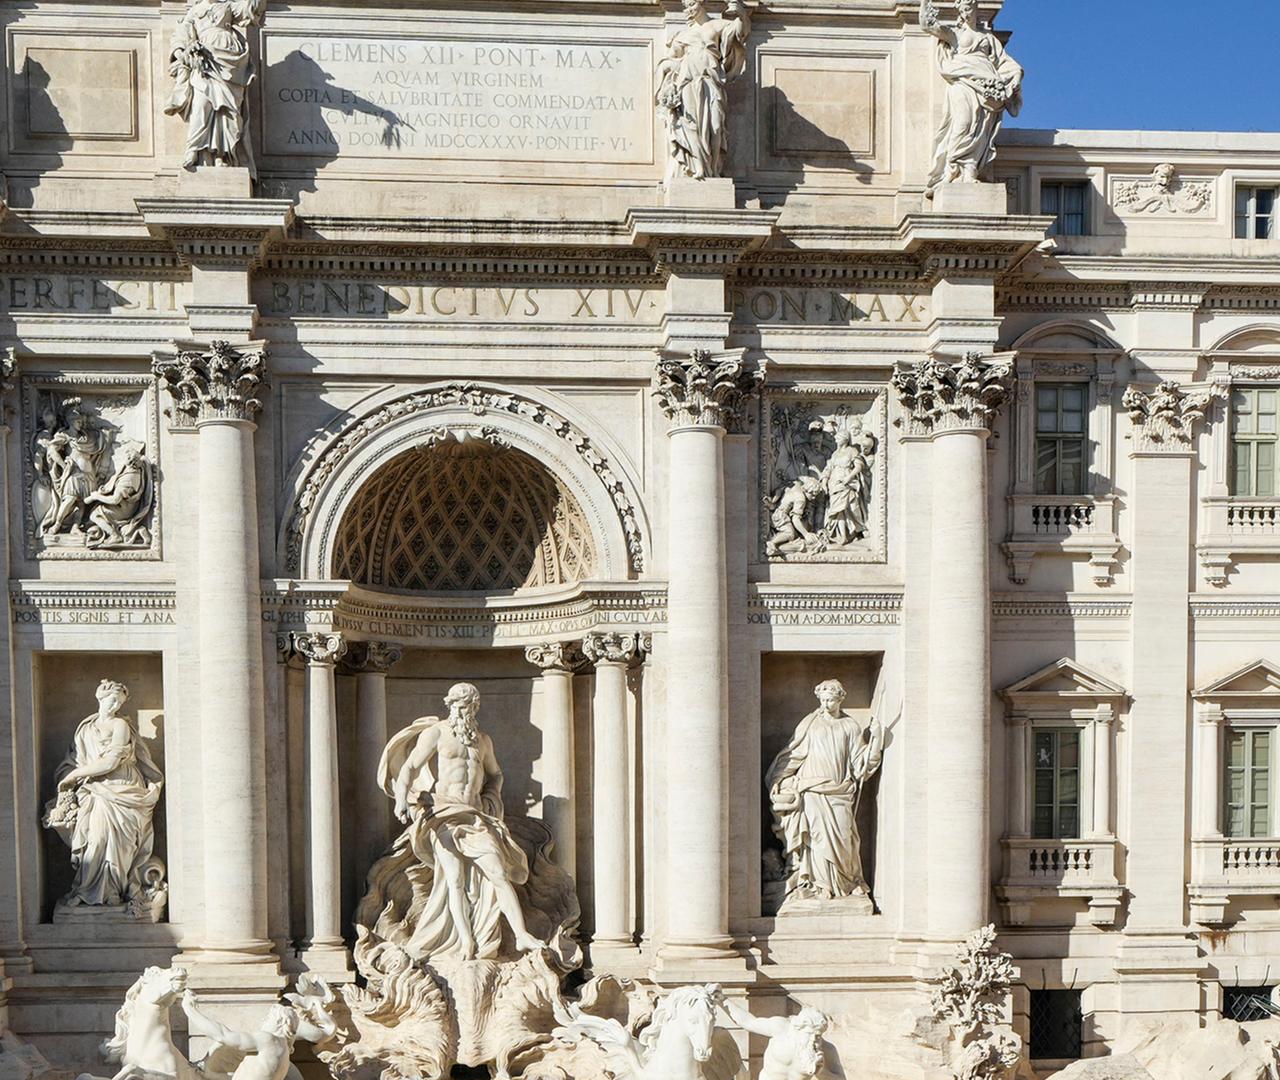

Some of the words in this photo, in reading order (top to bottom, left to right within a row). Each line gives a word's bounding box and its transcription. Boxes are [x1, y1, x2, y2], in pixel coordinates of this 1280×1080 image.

[299, 42, 408, 64] CLEMENS
[372, 71, 440, 88] AQVAM
[452, 72, 544, 88] VIRGINEM
[278, 88, 331, 104] COPIA
[341, 90, 361, 104] ET
[367, 91, 483, 107] SALVBRITATE
[493, 94, 635, 111] COMMENDATAM
[397, 112, 501, 129] MAGNIFICO
[509, 115, 592, 130] ORNAVIT
[288, 131, 342, 145] ANNO
[348, 131, 416, 148] DOMINI
[270, 280, 542, 317] BENEDICTVS
[69, 611, 110, 623] SIGNIS
[119, 612, 134, 623] ET
[142, 612, 175, 623] ANA
[747, 613, 800, 624] SOLVTVM
[369, 621, 447, 638] CLEMENTIS
